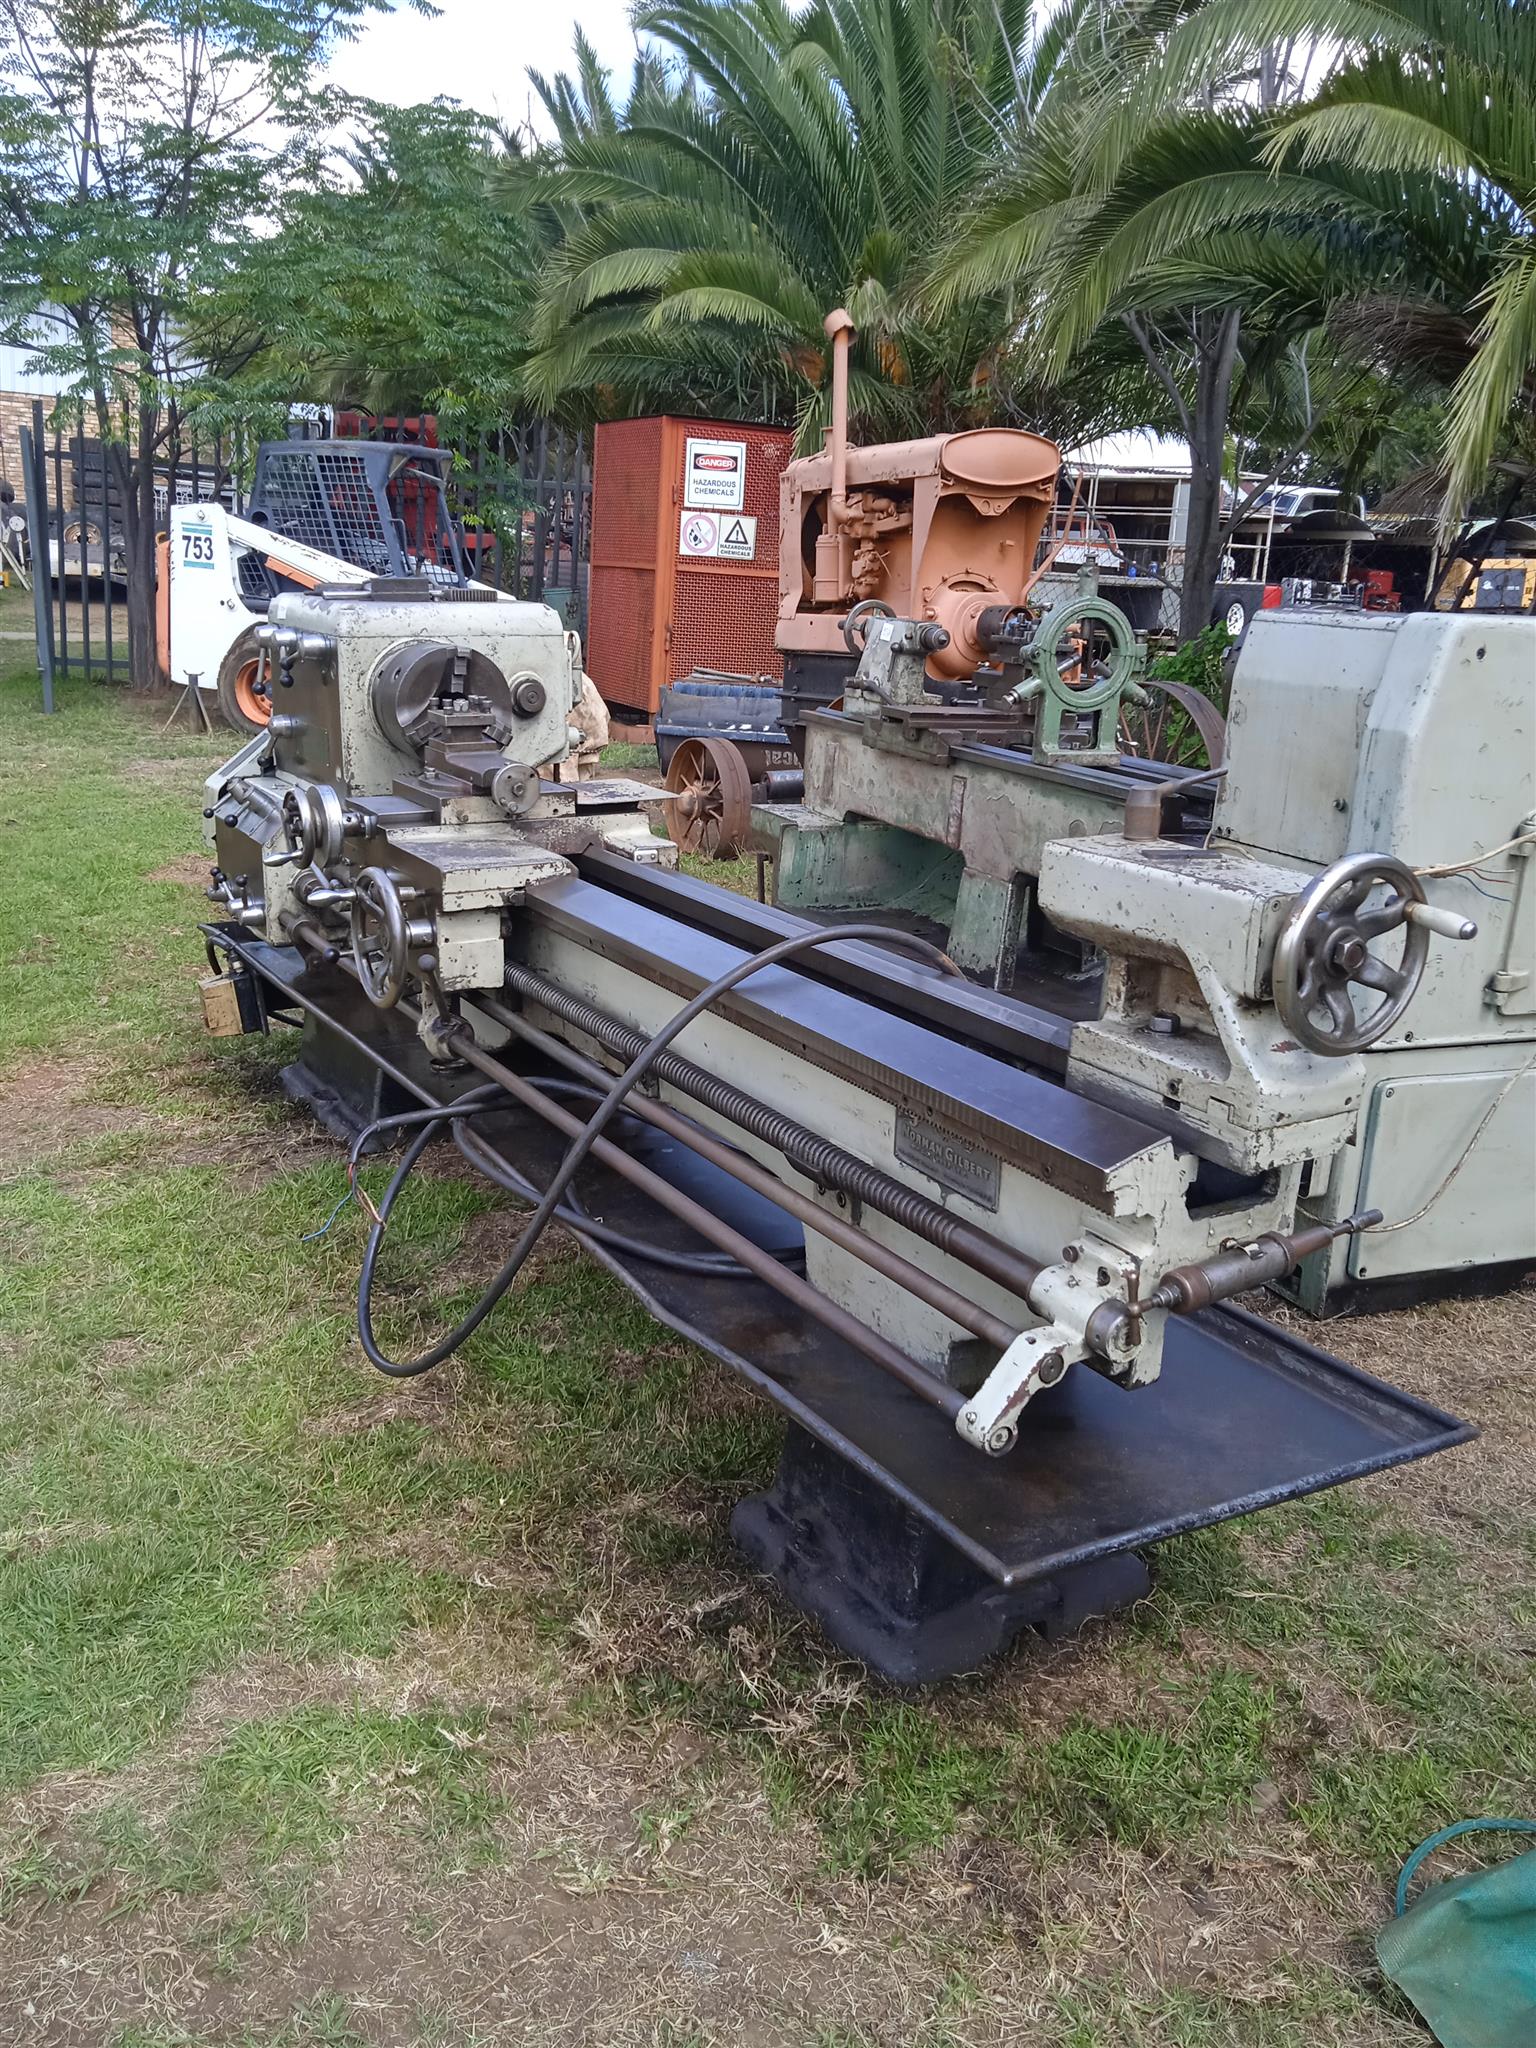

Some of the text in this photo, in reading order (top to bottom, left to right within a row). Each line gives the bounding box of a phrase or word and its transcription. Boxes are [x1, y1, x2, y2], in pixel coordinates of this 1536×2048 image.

[699, 458, 733, 468] DANGER
[693, 478, 736, 488] HAZARDOUS
[694, 487, 735, 496] CHEMICALS
[182, 535, 213, 560] 753
[720, 549, 751, 557] CHEMICALS
[903, 1124, 943, 1157] NORMAN
[945, 1147, 991, 1180] GILBERT
